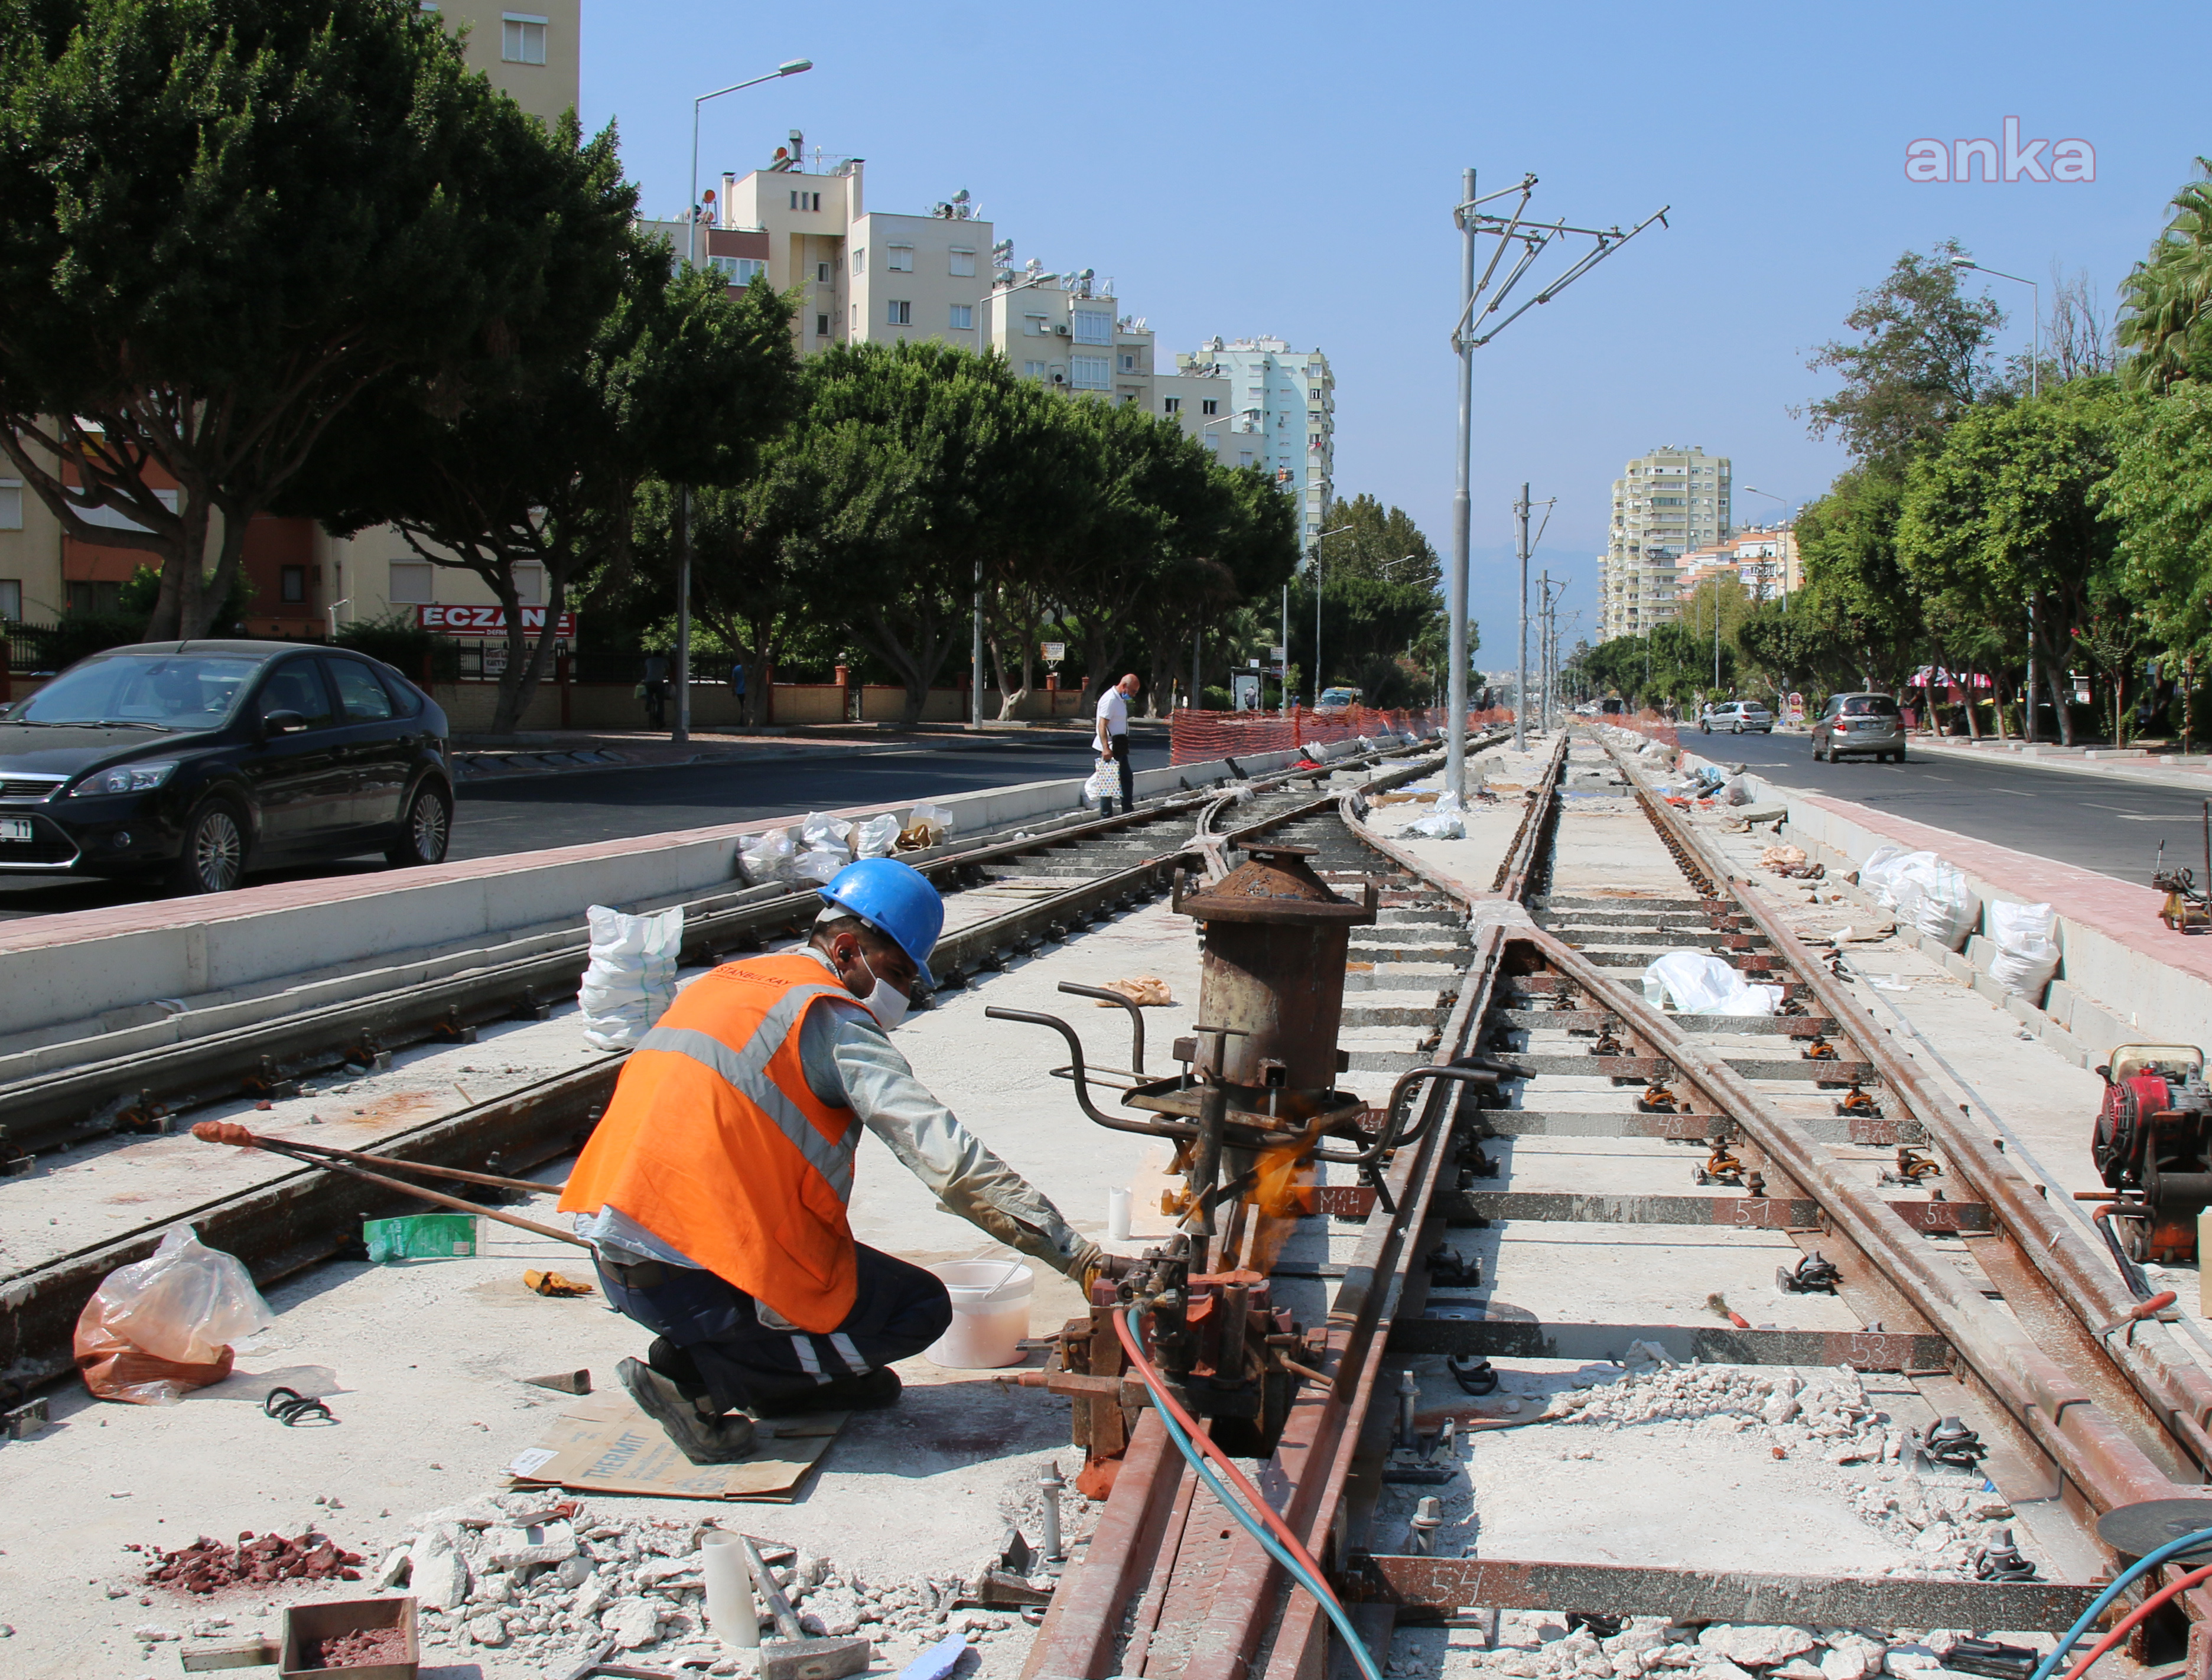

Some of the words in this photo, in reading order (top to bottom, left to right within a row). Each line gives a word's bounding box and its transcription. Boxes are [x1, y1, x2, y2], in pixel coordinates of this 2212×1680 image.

[1743, 956, 1758, 969] 36
[765, 976, 793, 986] RAY
[1658, 1115, 1684, 1135] 48
[1735, 1199, 1770, 1225] 51
[1847, 1333, 1887, 1365] 53
[581, 1430, 649, 1480] THERMIT
[1431, 1565, 1484, 1606] 54
